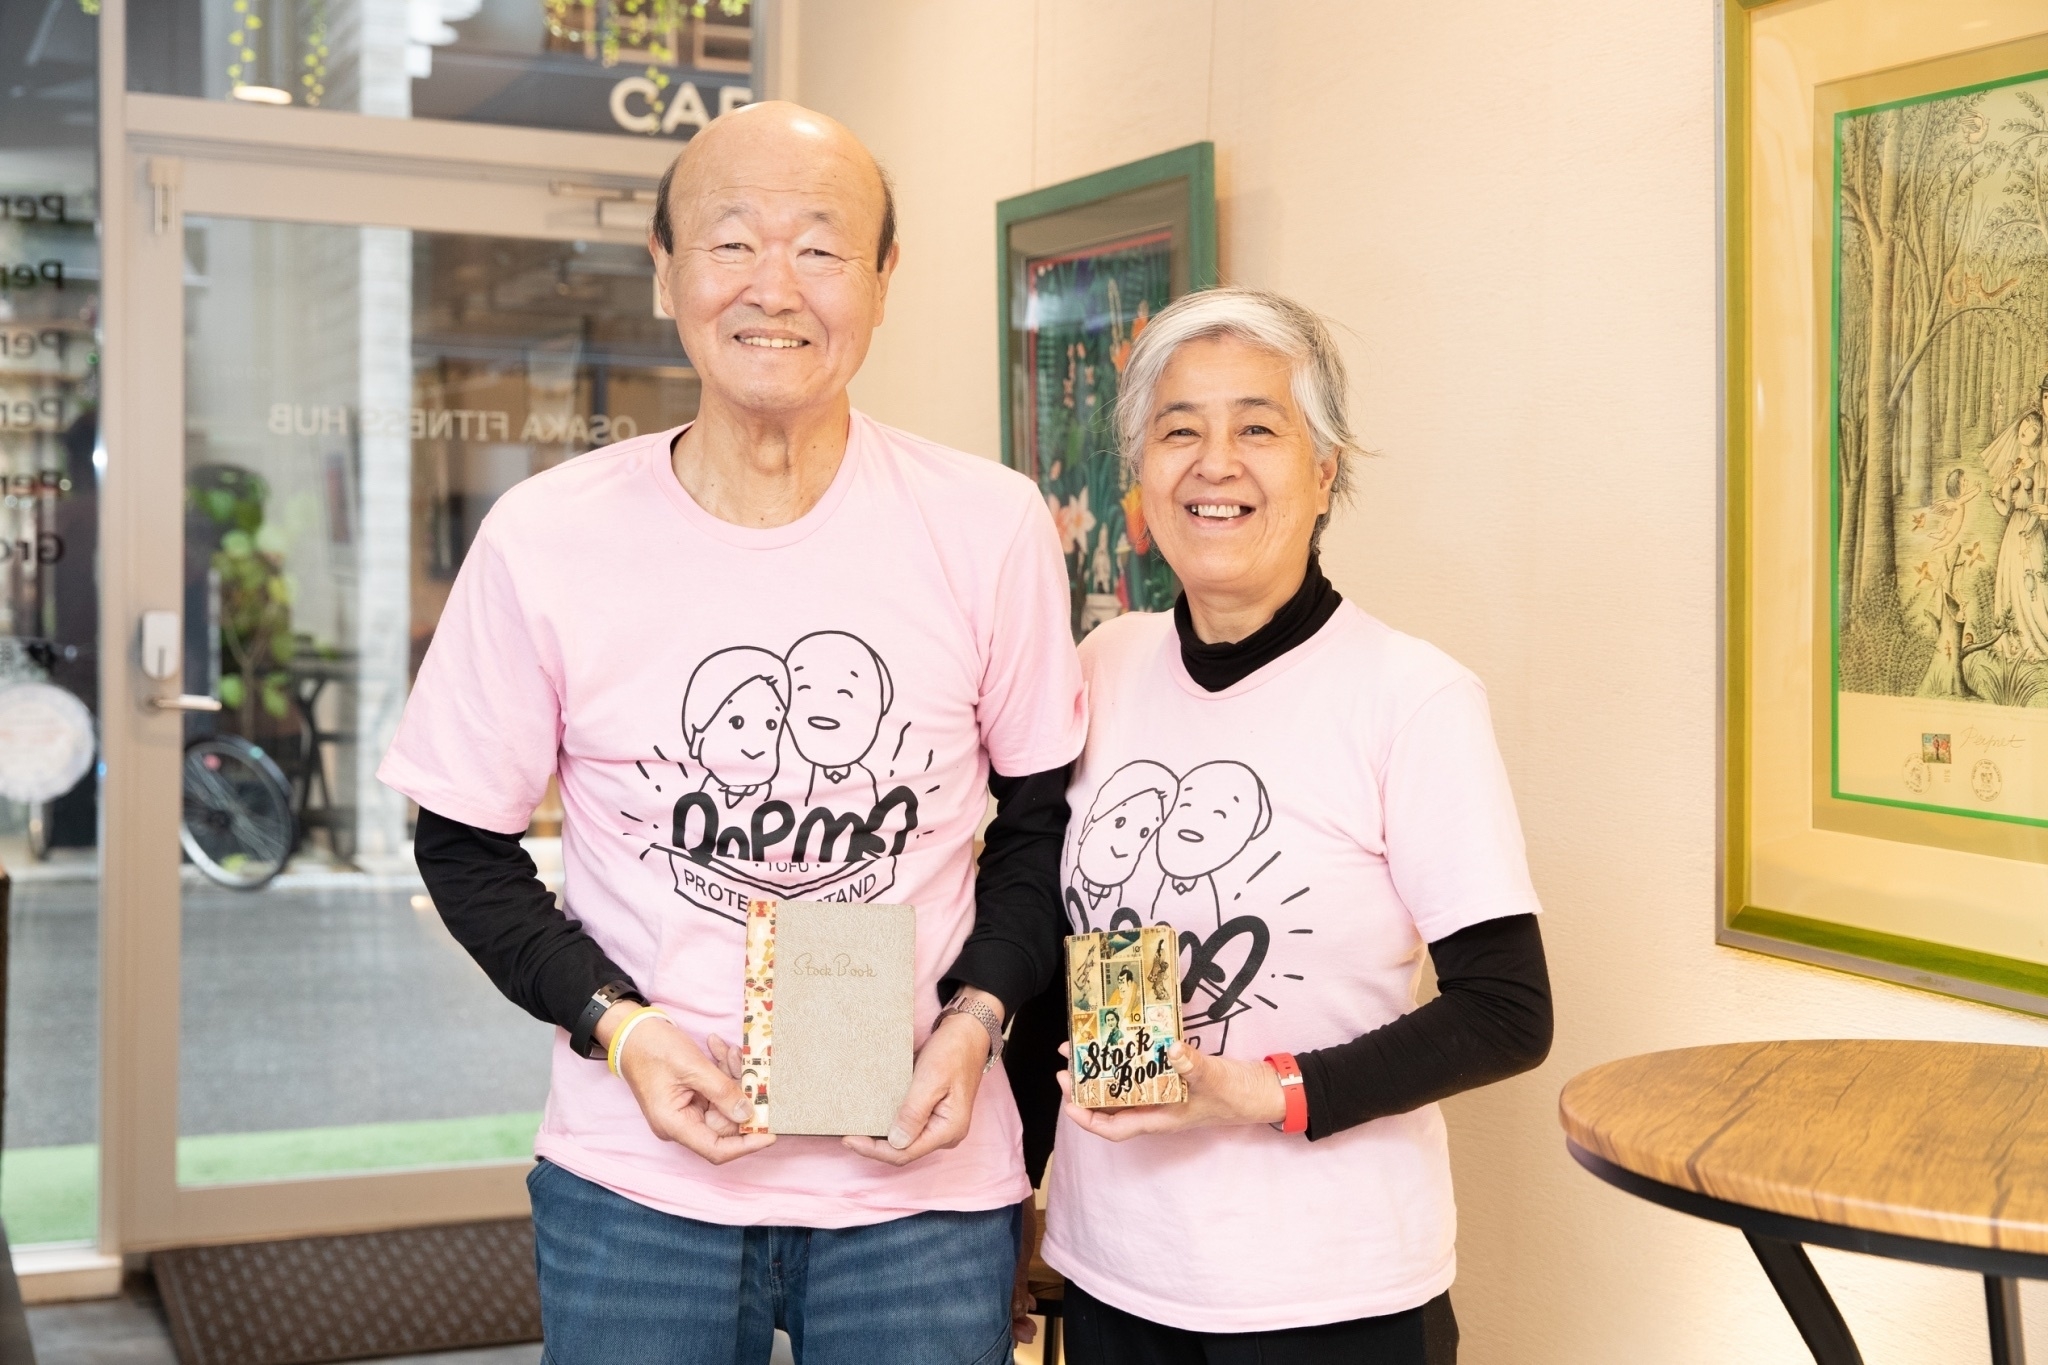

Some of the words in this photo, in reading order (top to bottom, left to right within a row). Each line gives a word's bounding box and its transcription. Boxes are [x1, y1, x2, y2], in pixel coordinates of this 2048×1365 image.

[684, 868, 749, 911] PROTE
[815, 873, 877, 903] TAND
[794, 952, 832, 977] Stock
[833, 952, 878, 978] Book
[1079, 1027, 1155, 1084] Stock
[1109, 1044, 1174, 1098] Book
